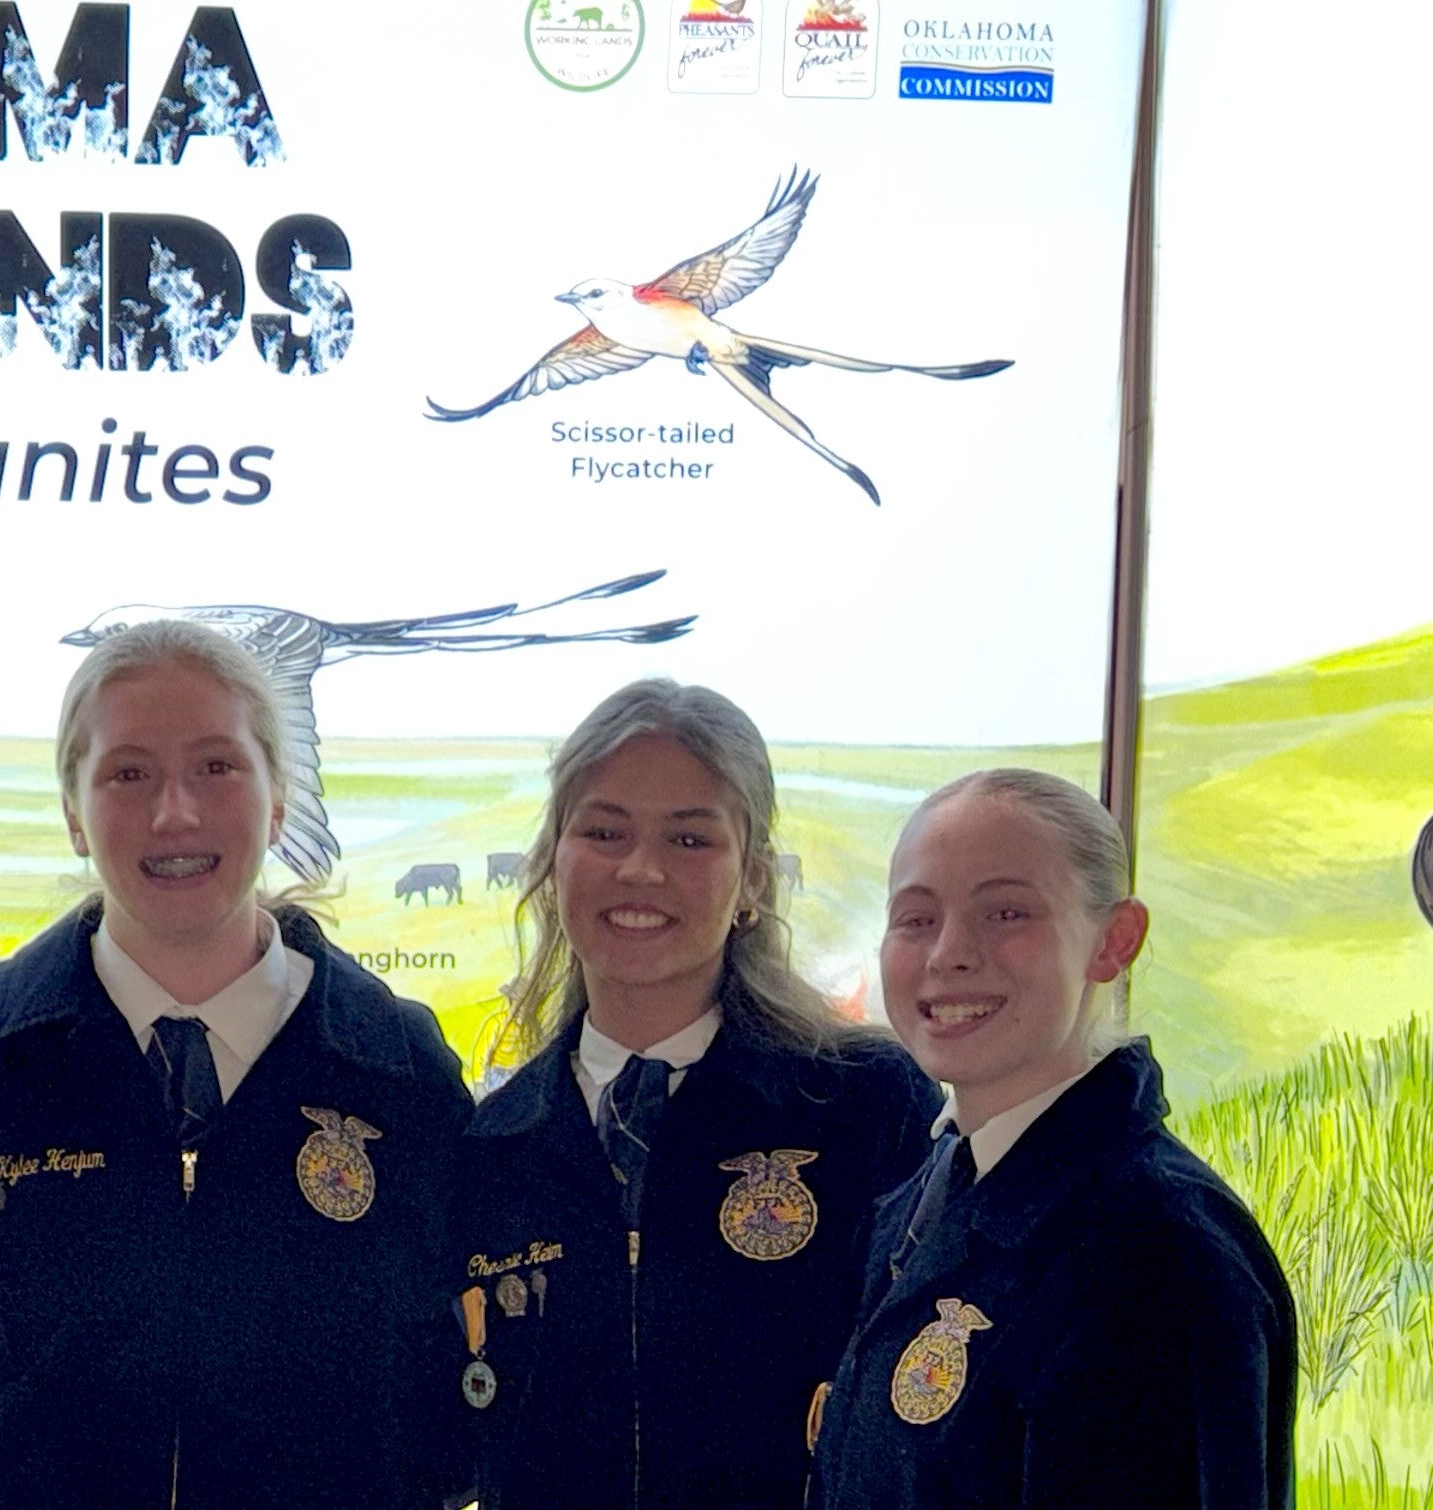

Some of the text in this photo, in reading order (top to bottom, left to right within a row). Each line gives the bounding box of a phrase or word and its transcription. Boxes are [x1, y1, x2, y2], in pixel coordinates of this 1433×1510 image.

[678, 23, 755, 38] PHEASANTS
[794, 32, 868, 50] QUAIL
[903, 19, 1055, 42] OKLAHOMA
[900, 43, 1055, 63] CONSERVATION
[900, 77, 1050, 99] COMMISSION
[550, 421, 735, 445] Scissor-tailed
[571, 456, 714, 483] Flycatcher
[347, 946, 456, 973] nghorn
